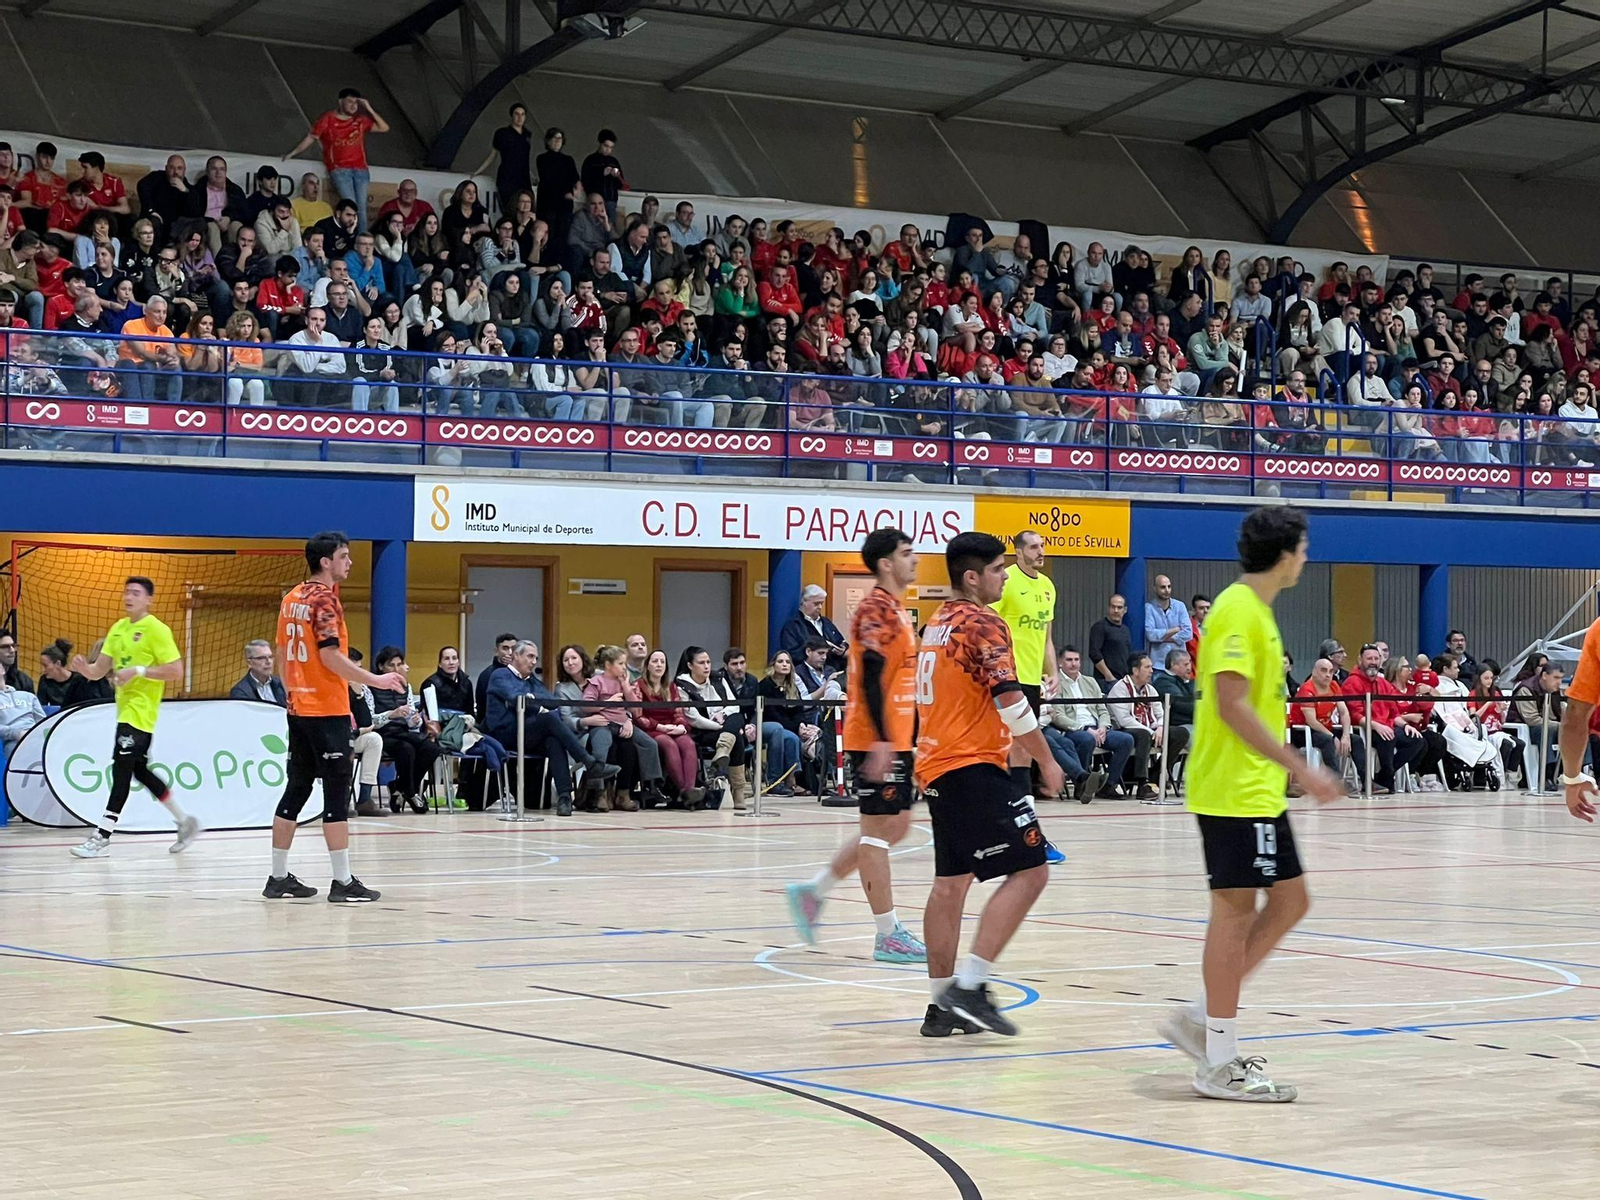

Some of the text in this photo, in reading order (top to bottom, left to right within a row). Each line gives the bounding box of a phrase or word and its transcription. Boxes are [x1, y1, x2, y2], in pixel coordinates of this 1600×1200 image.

[246, 172, 295, 198] ID
[102, 405, 118, 413] IMD
[465, 502, 497, 520] IMD
[1029, 507, 1081, 532] NO8DO
[465, 521, 594, 536] Instituto Municipal de Deportes
[642, 500, 961, 545] C.D. EL PARAGUAS
[1069, 536, 1082, 547] DE
